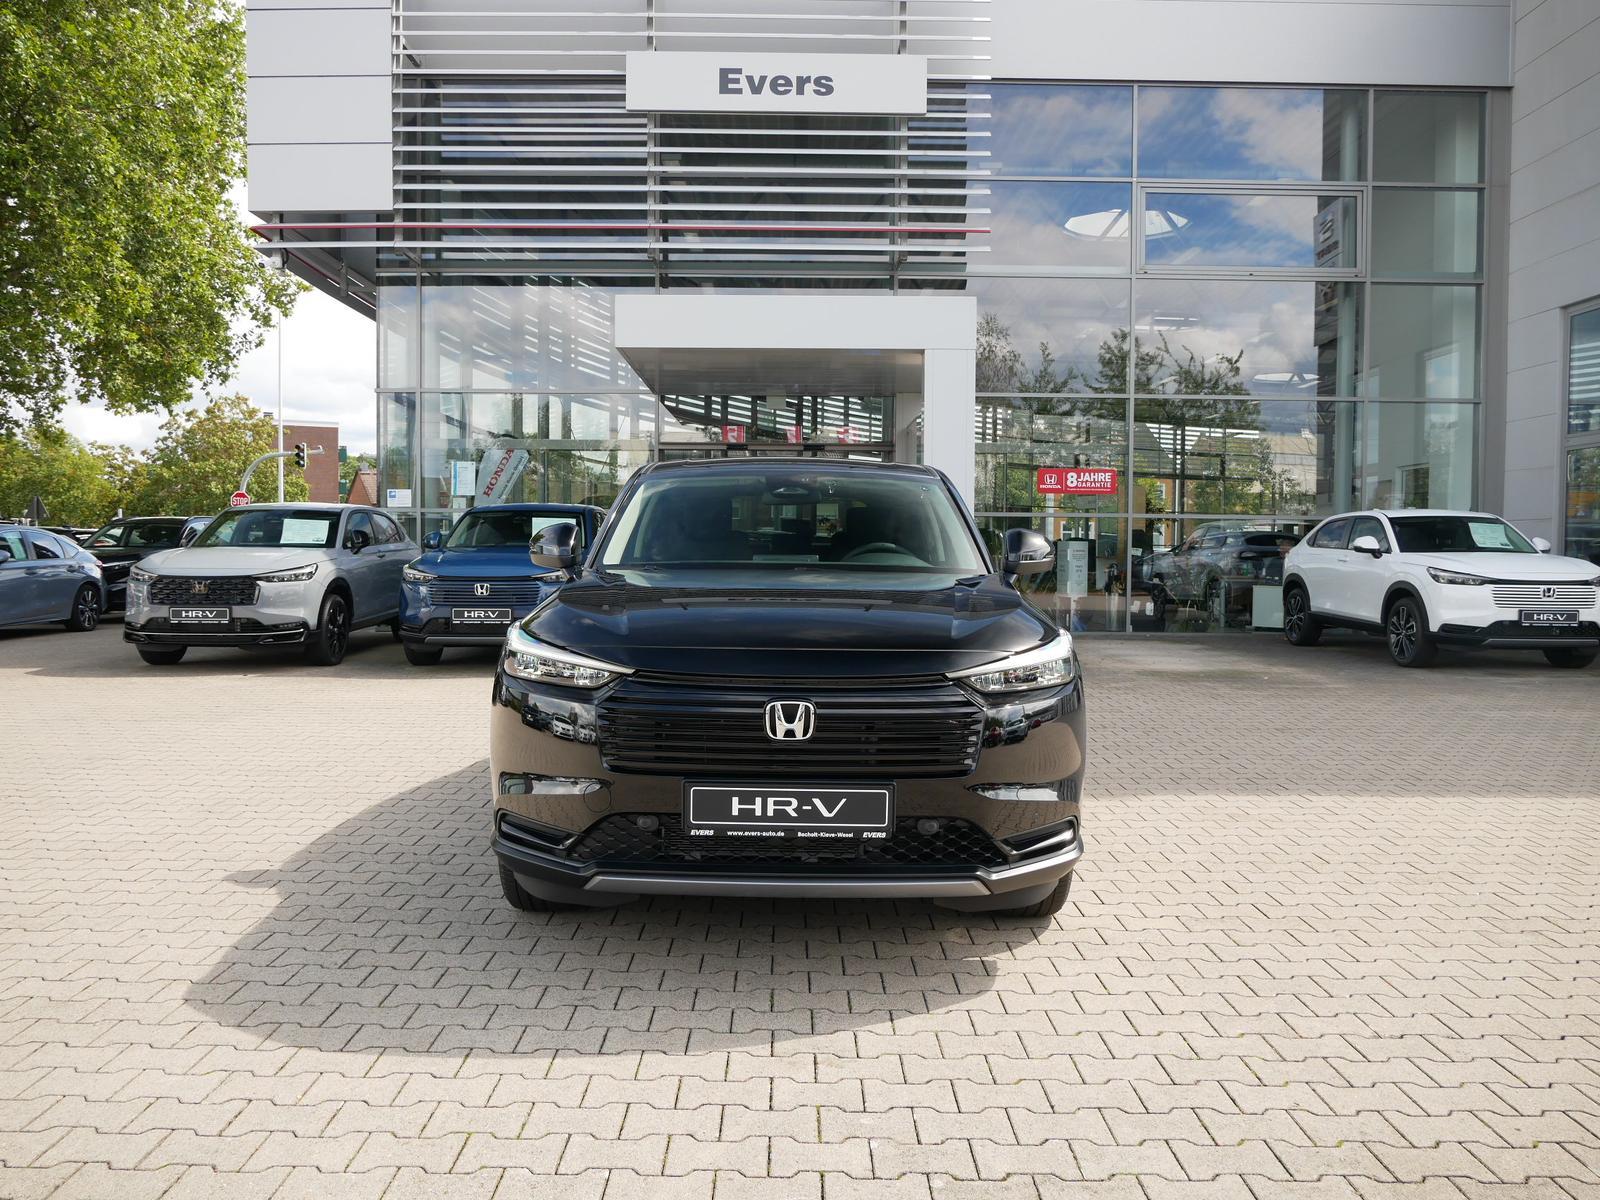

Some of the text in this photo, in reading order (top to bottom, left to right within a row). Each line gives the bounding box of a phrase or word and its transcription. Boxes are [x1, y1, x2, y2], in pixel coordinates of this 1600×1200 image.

[718, 67, 835, 97] Evers
[483, 448, 514, 497] HONDA
[1066, 472, 1111, 487] 8 JAHRE
[232, 497, 248, 505] STOP
[181, 610, 217, 618] HR-V
[731, 796, 847, 818] HR-V
